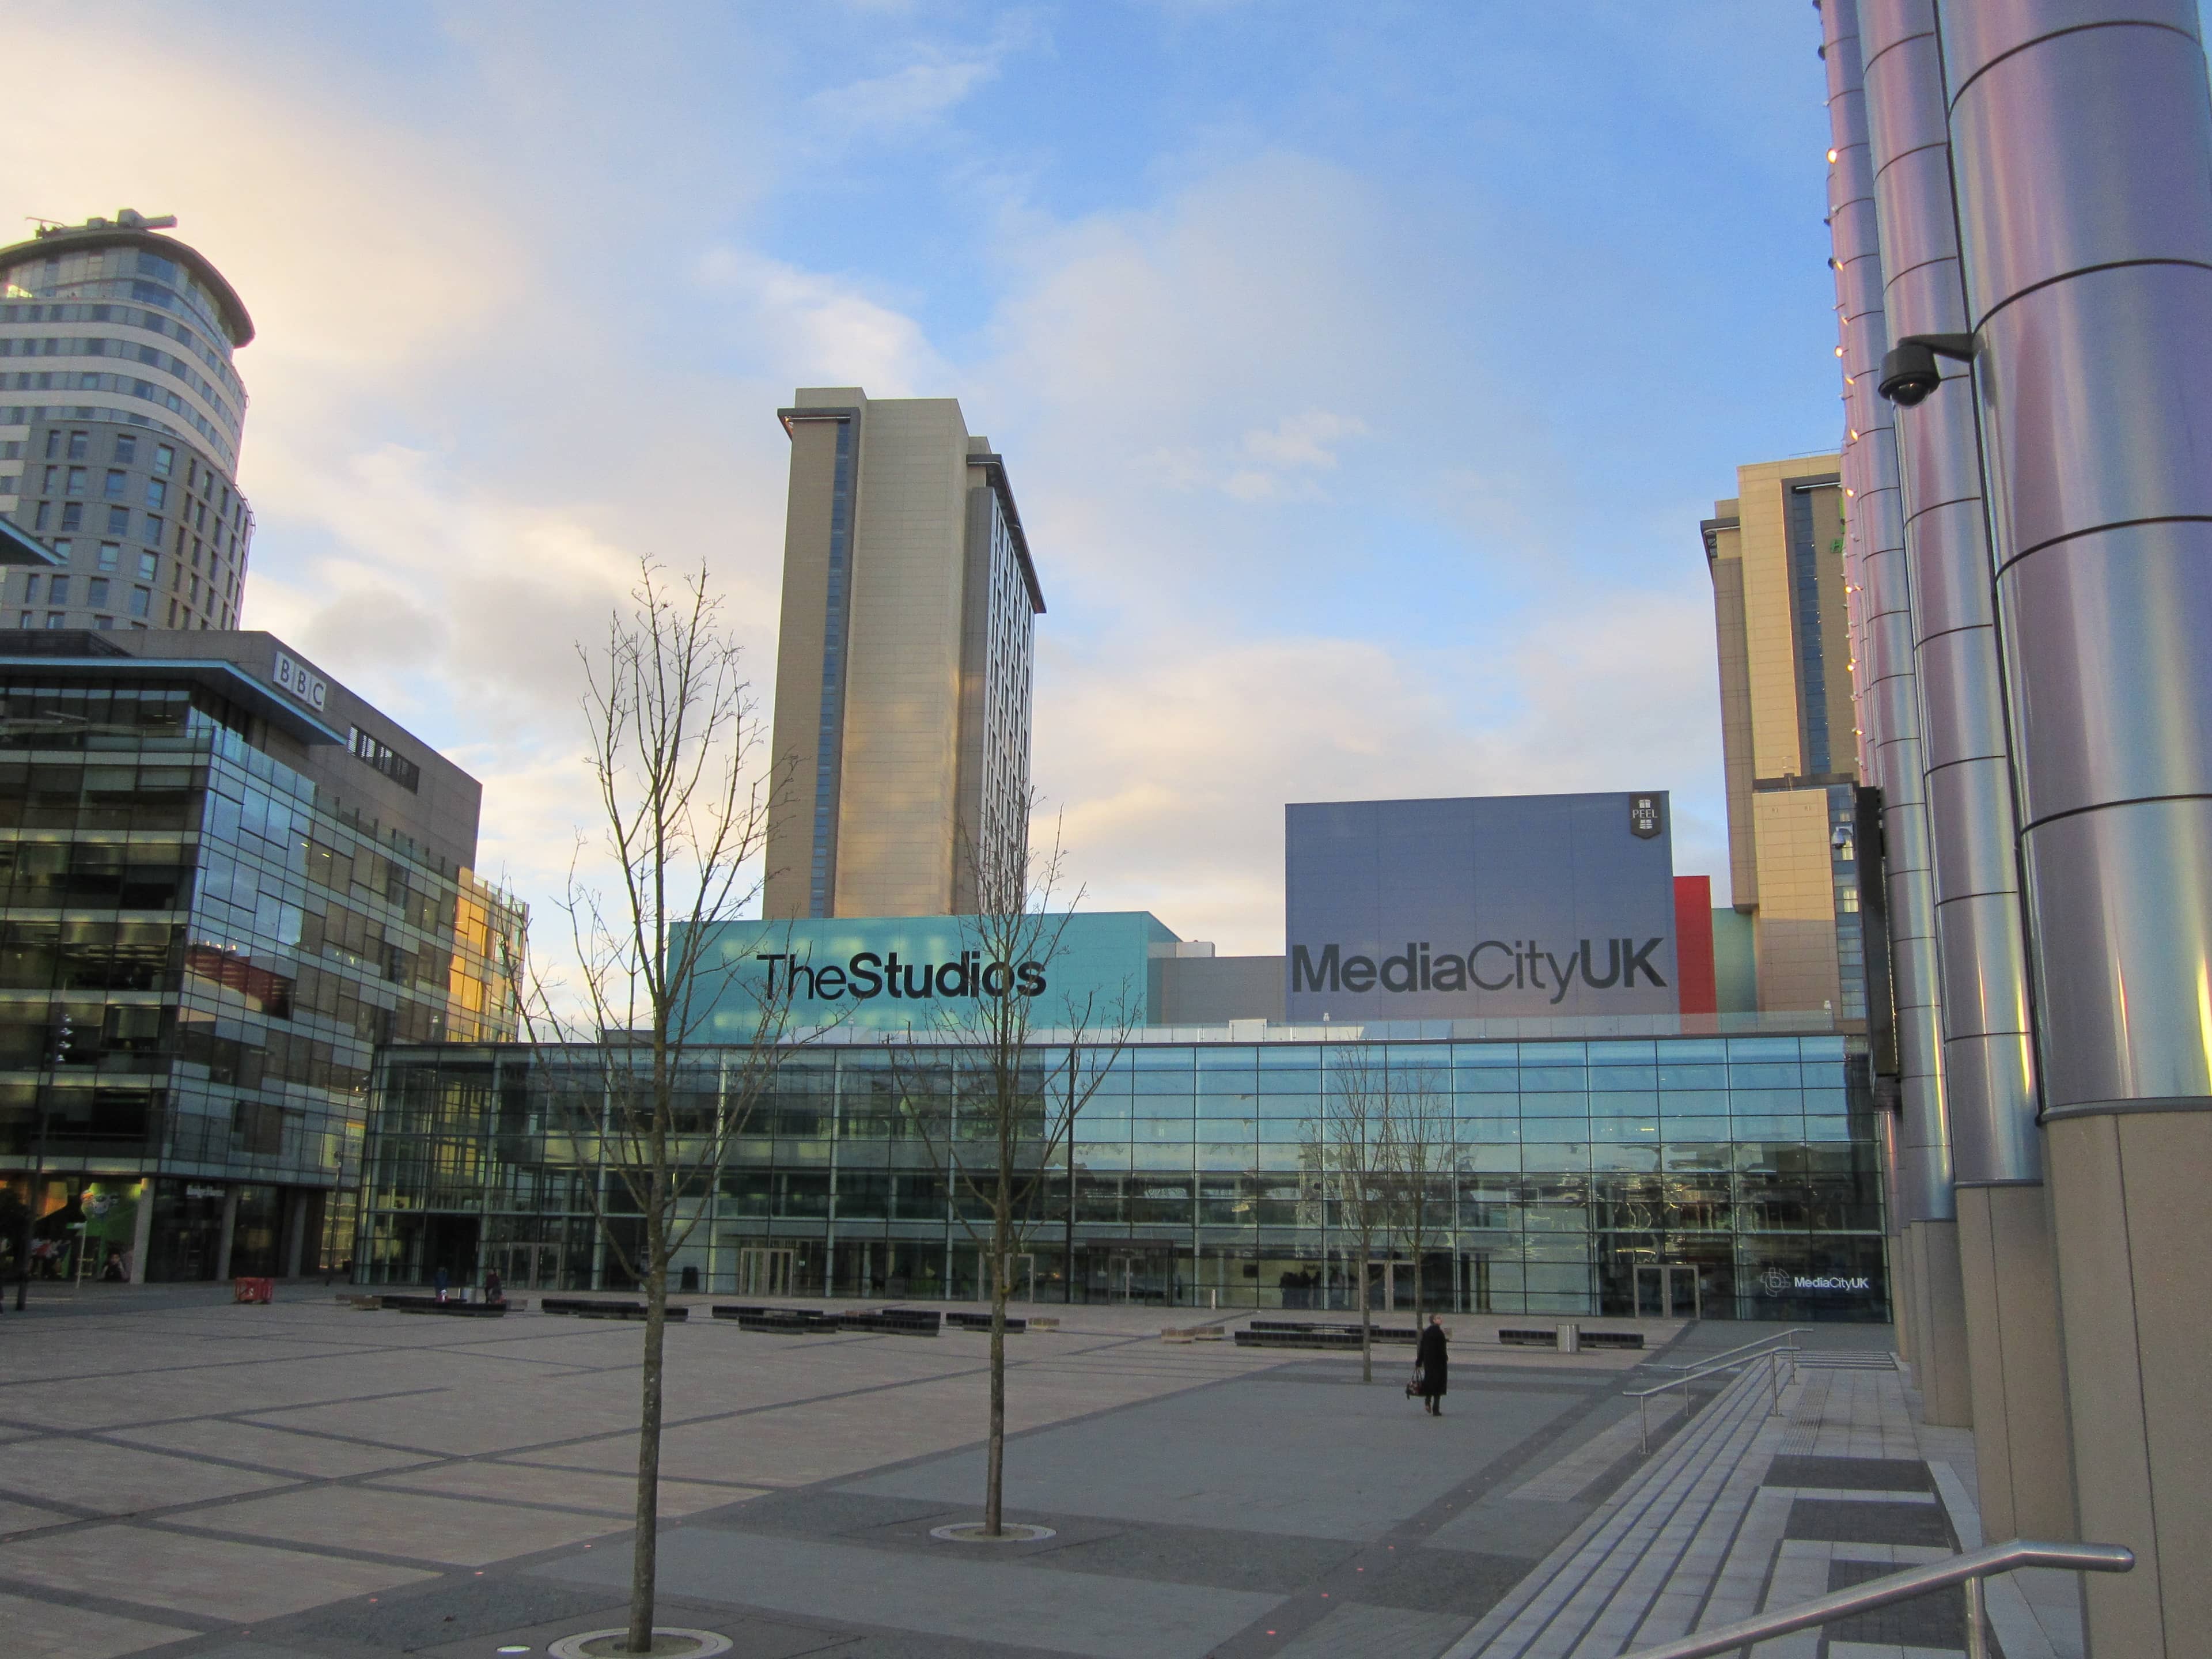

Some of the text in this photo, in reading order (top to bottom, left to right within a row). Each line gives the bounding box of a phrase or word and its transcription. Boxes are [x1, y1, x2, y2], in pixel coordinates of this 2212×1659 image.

[281, 658, 324, 706] BBC
[1633, 809, 1658, 819] PEEL
[756, 950, 1047, 1001] TheStudios
[1291, 937, 1668, 1005] MediaCityUK
[1794, 1277, 1869, 1291] MediaCityUK
